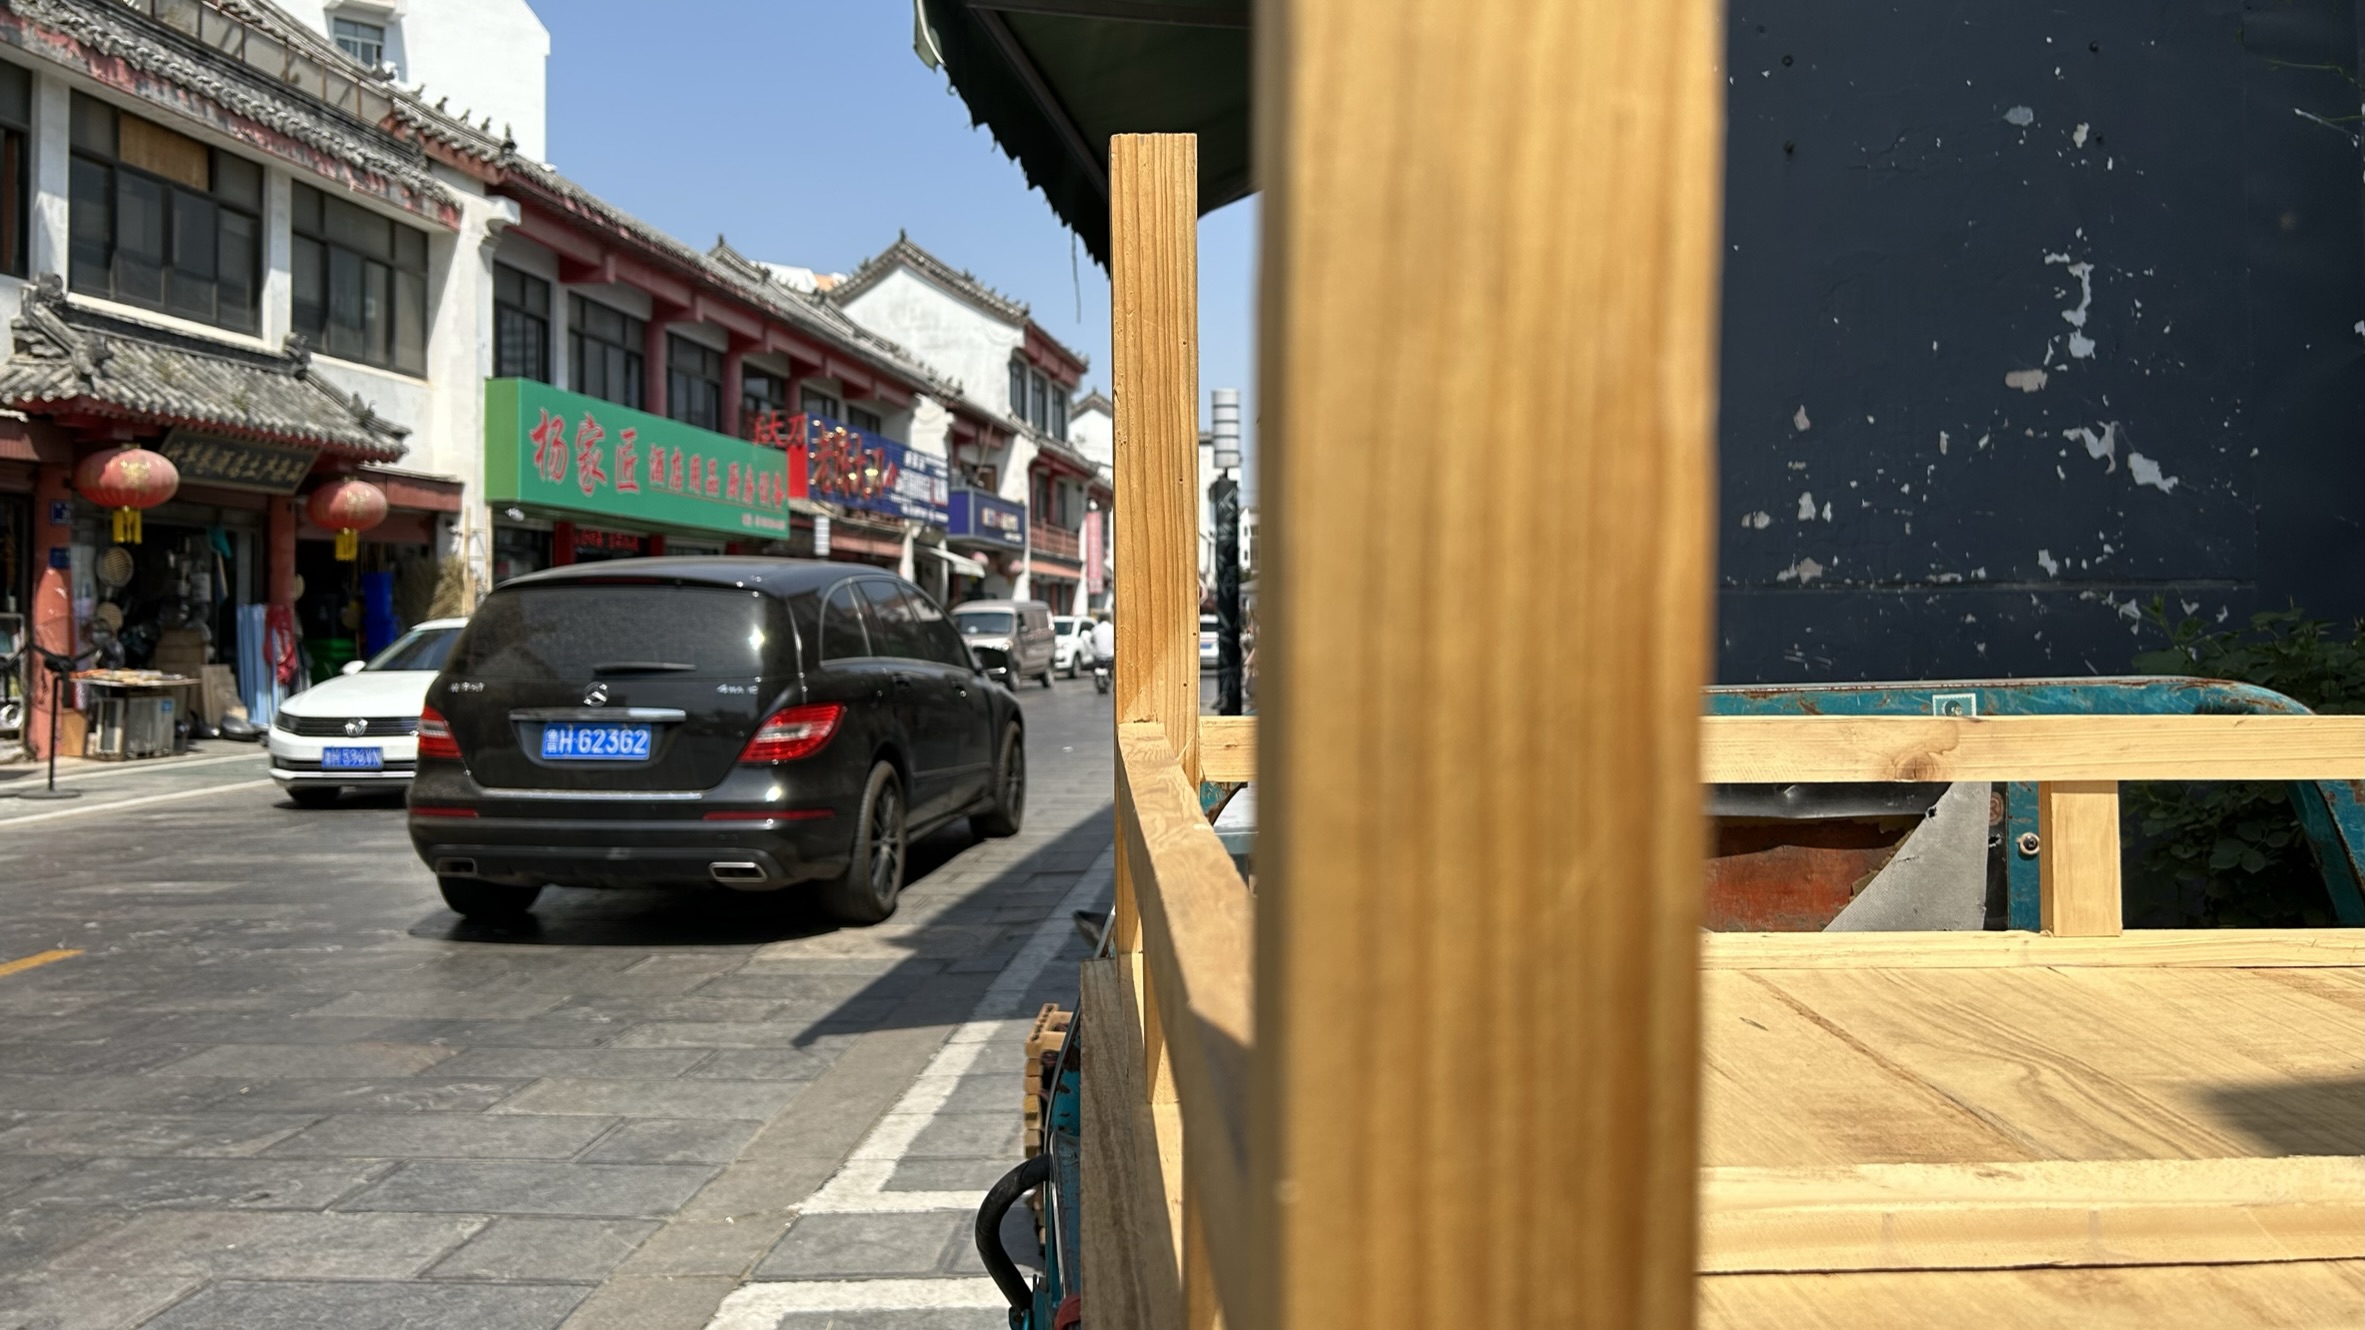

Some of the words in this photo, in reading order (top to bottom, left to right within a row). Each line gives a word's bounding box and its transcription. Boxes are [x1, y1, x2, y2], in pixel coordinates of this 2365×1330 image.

[529, 406, 640, 498] 杨家匠
[648, 441, 720, 497] 酒店用品
[726, 461, 785, 508] 厨房设备
